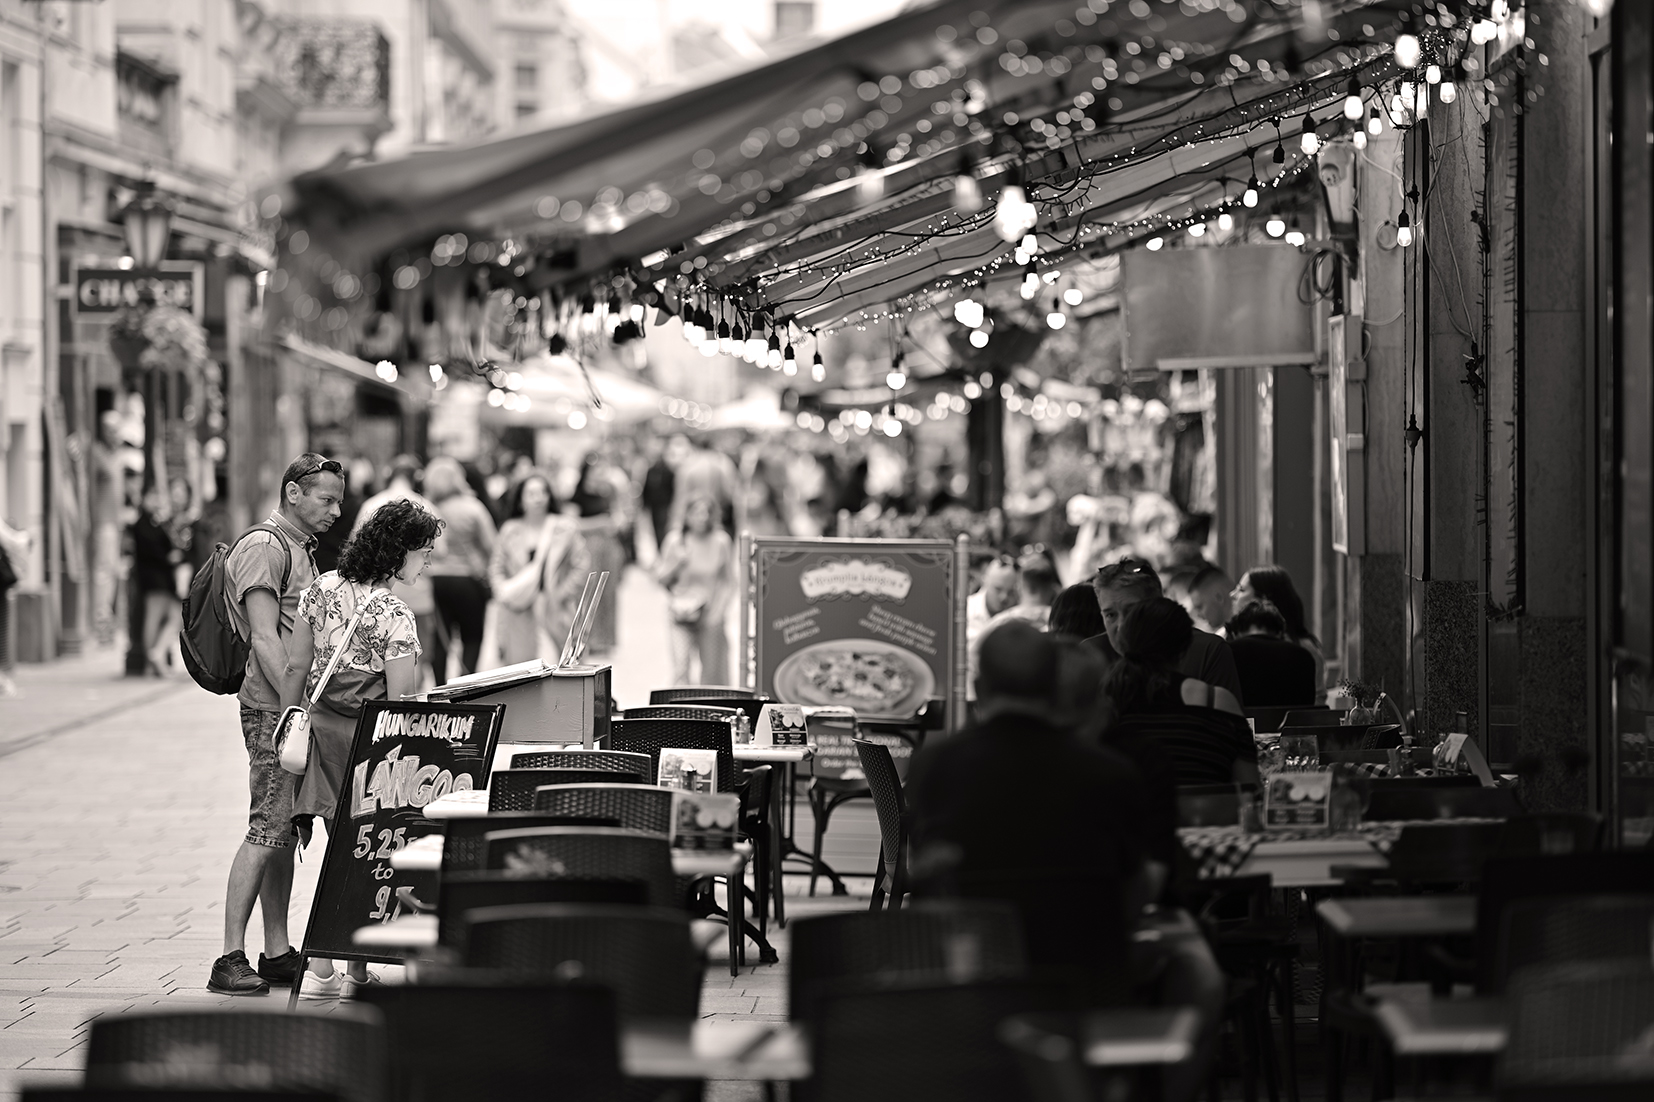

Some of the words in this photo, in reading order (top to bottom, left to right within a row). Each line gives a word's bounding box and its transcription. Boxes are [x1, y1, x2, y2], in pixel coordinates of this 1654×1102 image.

[80, 278, 193, 308] CHAGE
[372, 709, 475, 746] HUNGARIKUM
[371, 862, 394, 880] to
